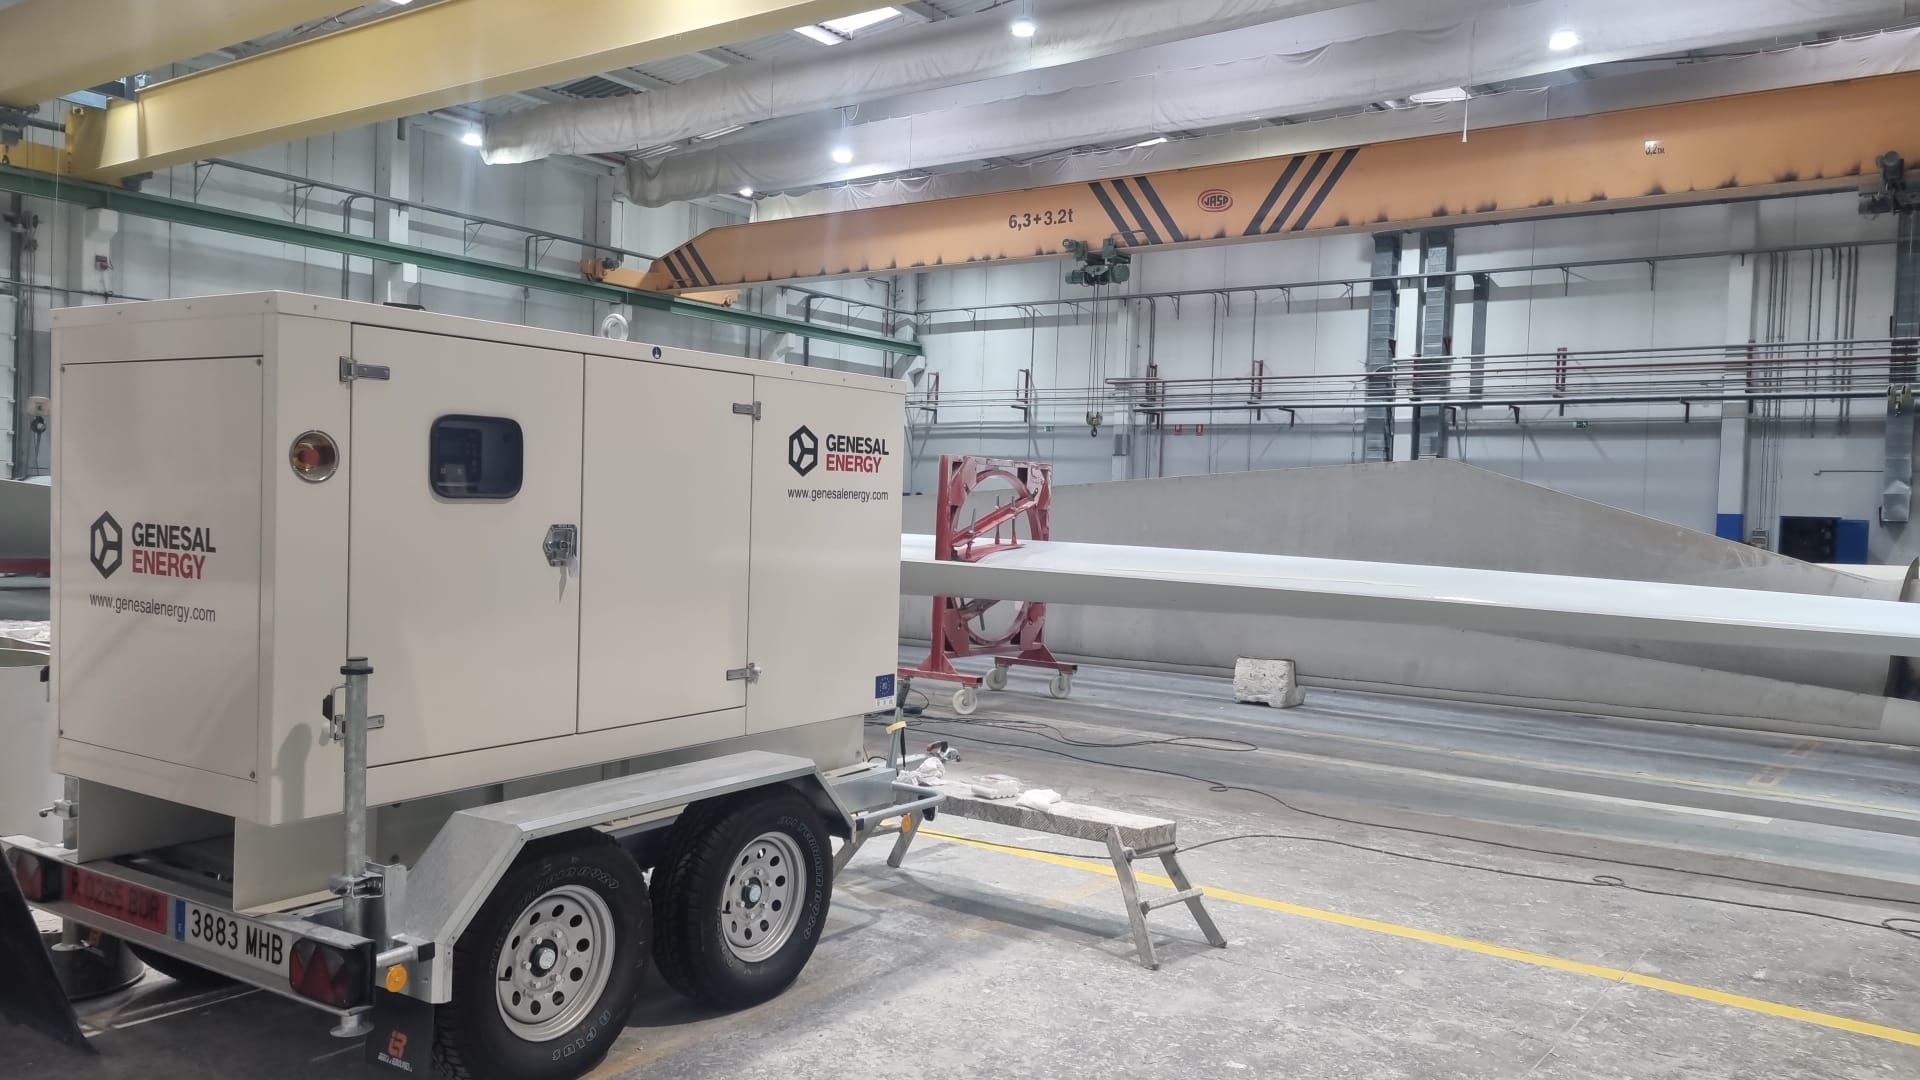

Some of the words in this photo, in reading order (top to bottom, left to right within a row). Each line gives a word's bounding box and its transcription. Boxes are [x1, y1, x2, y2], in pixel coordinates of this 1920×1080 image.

[826, 433, 889, 456] GENESAL
[826, 453, 882, 473] ENERGY
[787, 487, 889, 503] www.genesalenergy.com
[132, 522, 217, 553] GENESAL
[132, 549, 206, 580] ENERGY
[90, 593, 216, 623] www.genesalenergy.com
[191, 908, 239, 950] 3883
[245, 925, 283, 965] MHB
